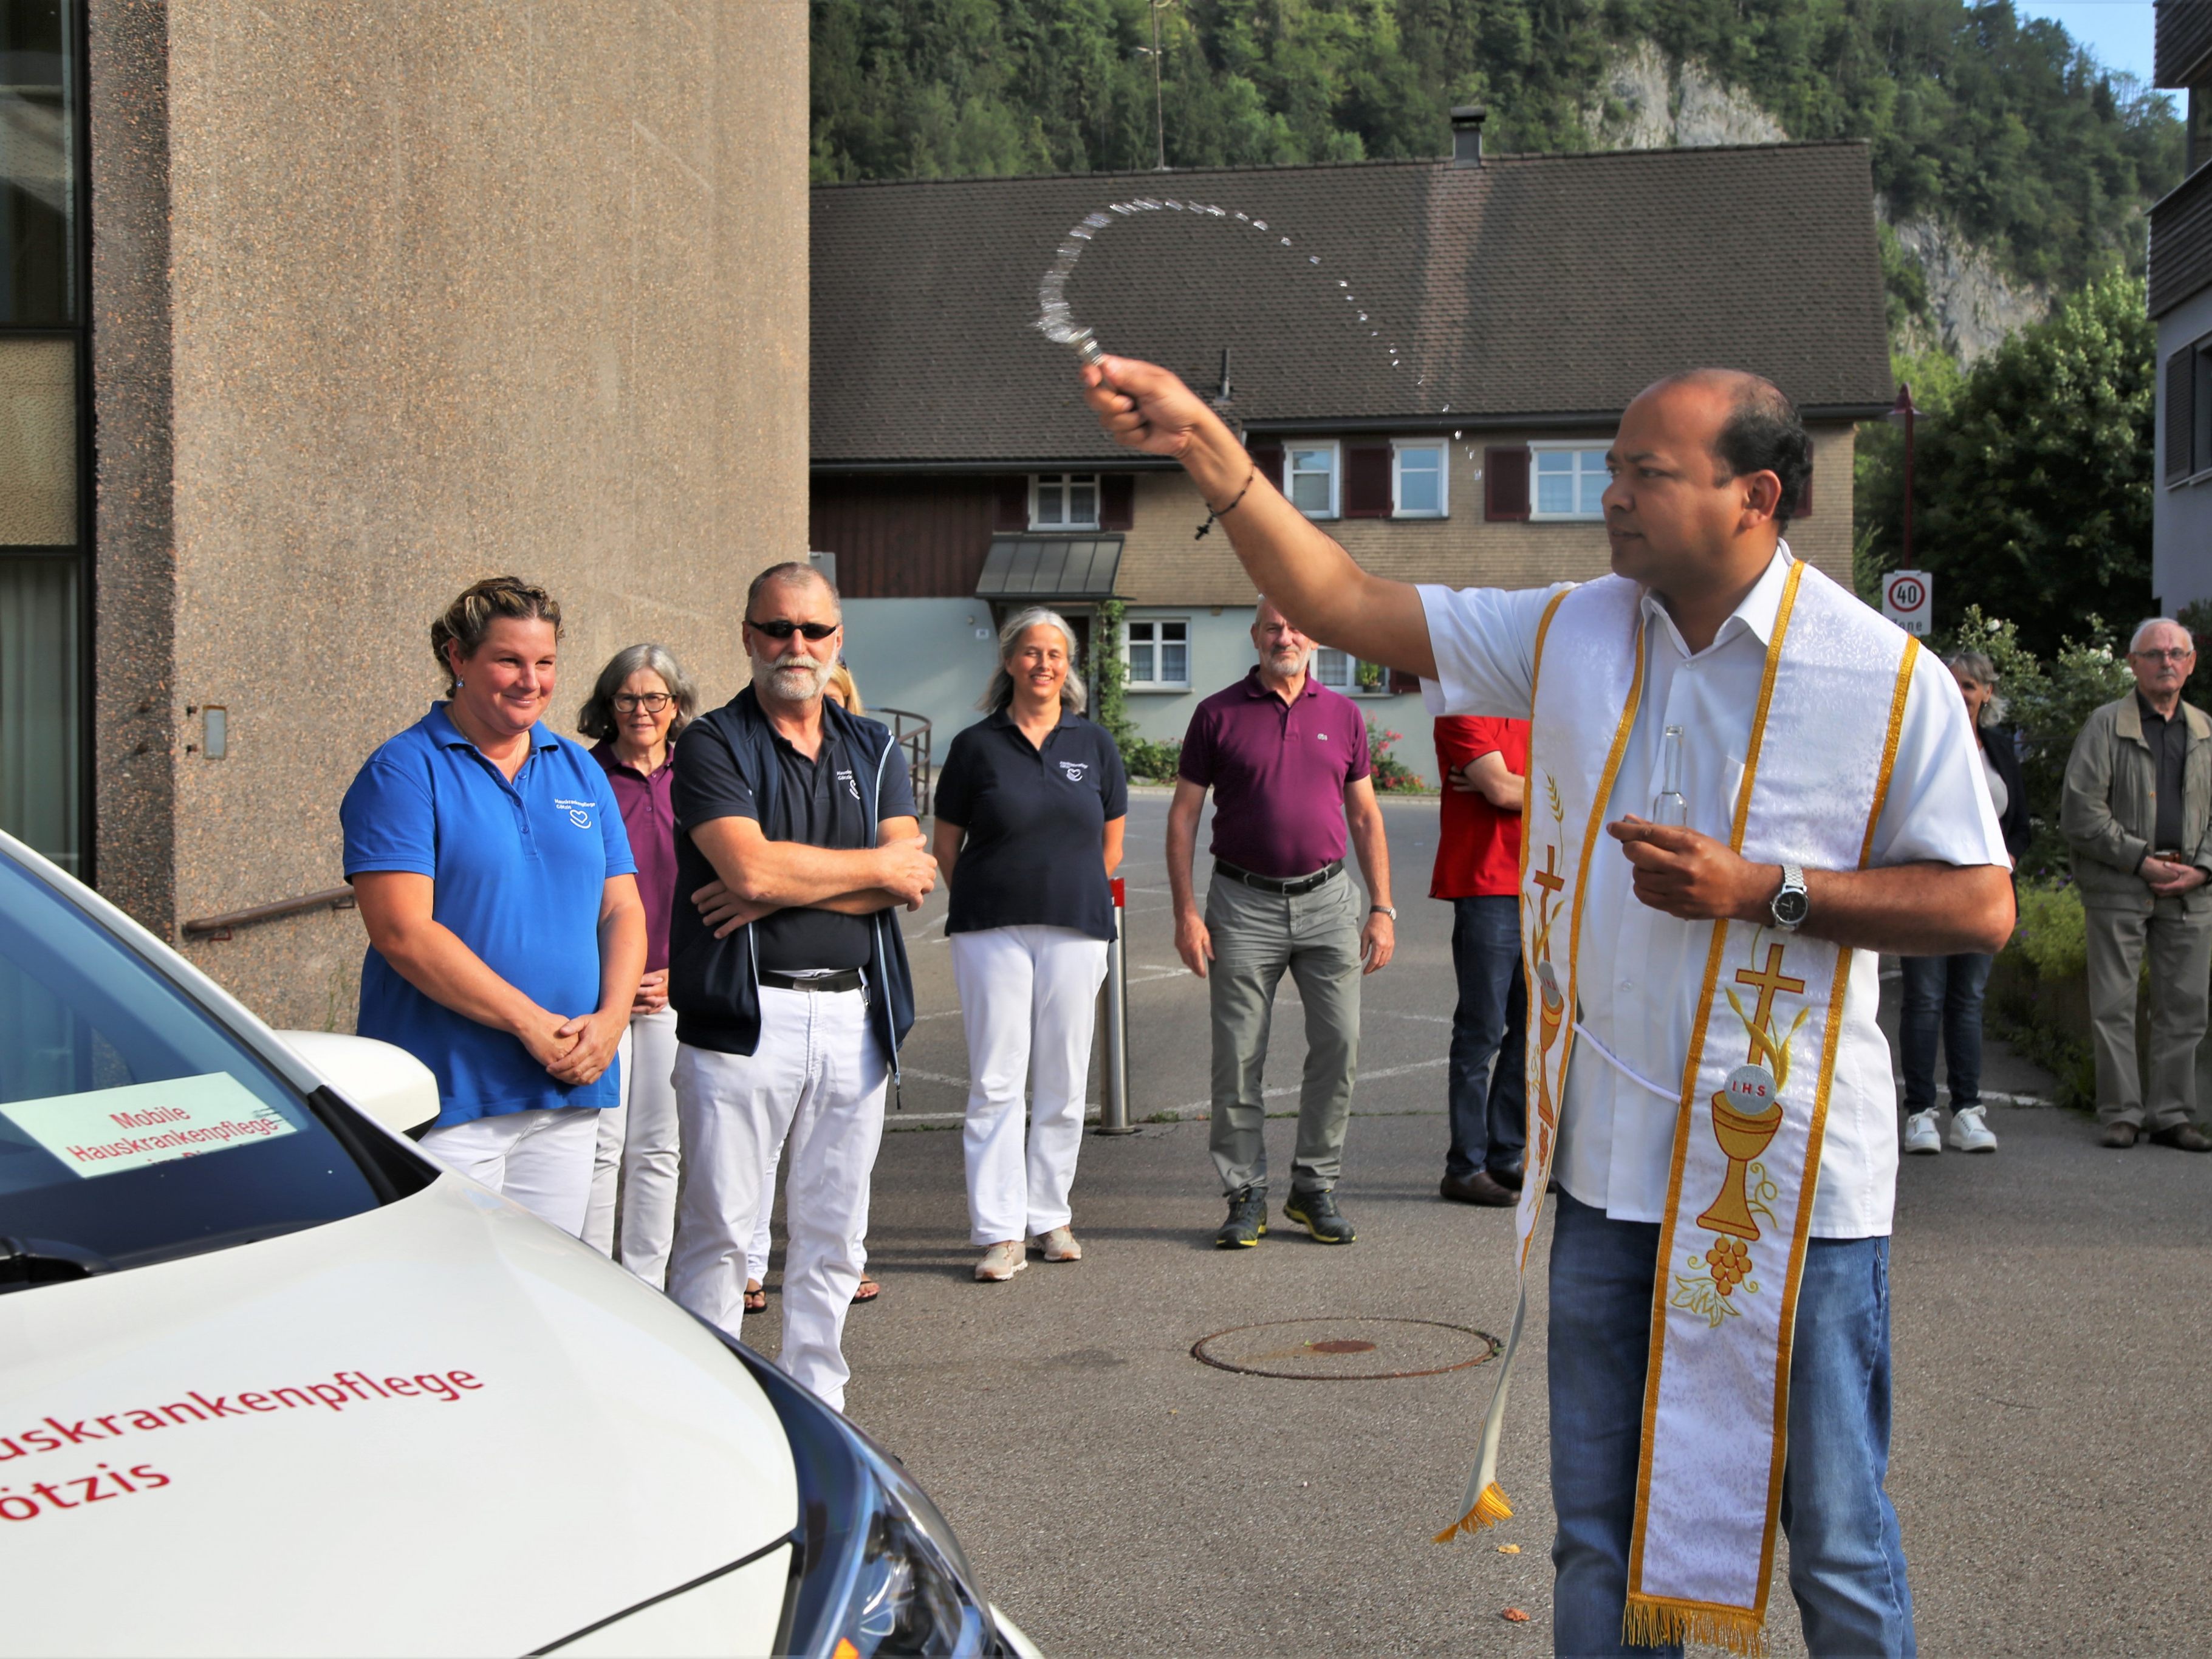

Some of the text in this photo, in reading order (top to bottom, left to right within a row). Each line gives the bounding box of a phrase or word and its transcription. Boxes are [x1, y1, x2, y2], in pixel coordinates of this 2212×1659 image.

[1897, 585, 1917, 604] 40
[1731, 1080, 1766, 1097] IHS
[109, 1106, 191, 1130] Mobile
[66, 1117, 279, 1163] Hauskrankenpflege
